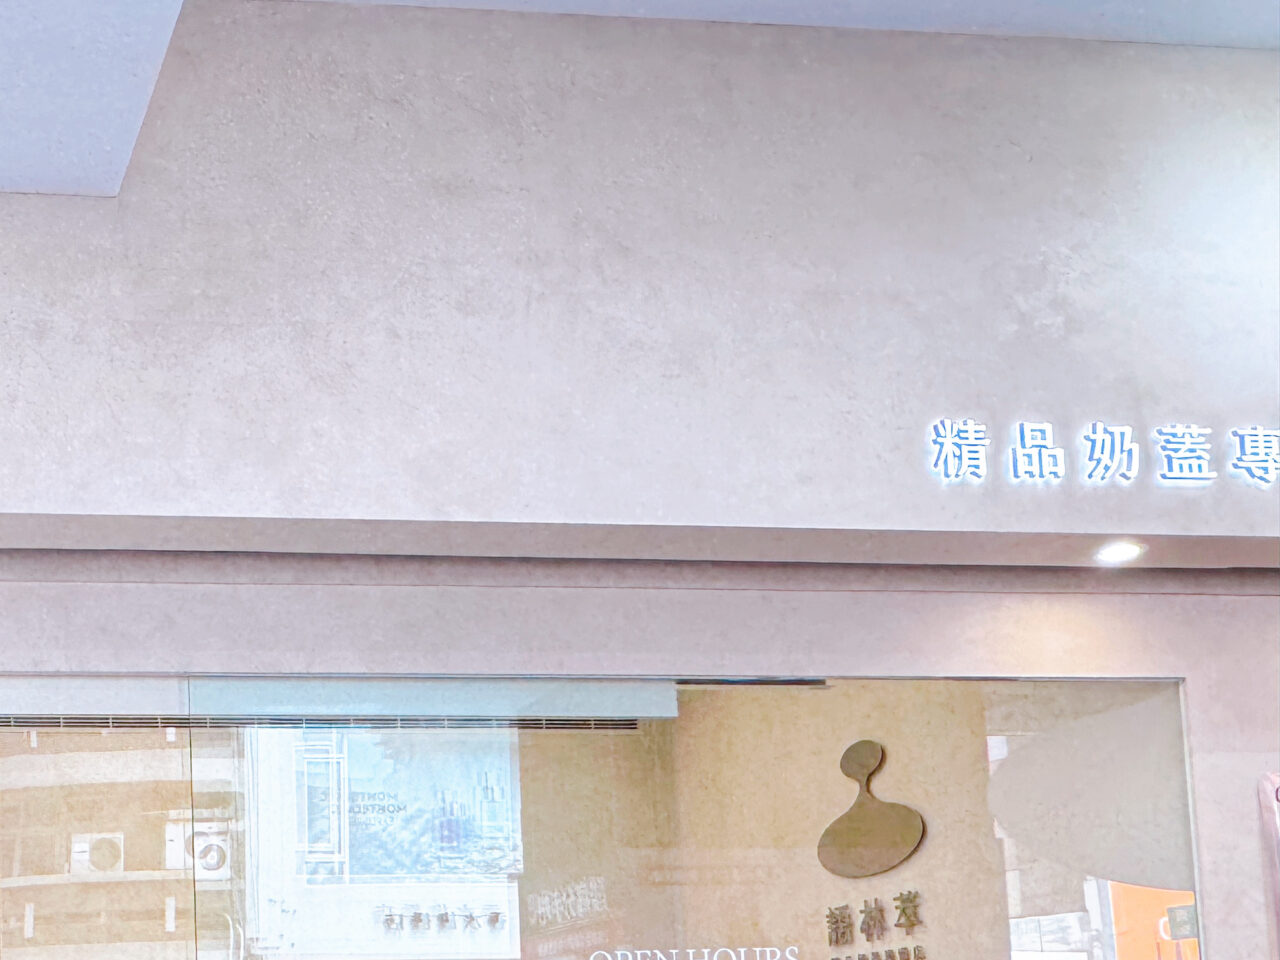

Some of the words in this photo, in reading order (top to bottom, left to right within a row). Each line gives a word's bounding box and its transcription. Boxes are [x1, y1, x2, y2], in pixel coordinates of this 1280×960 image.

[930, 418, 1280, 484] 精品奶蓋專
